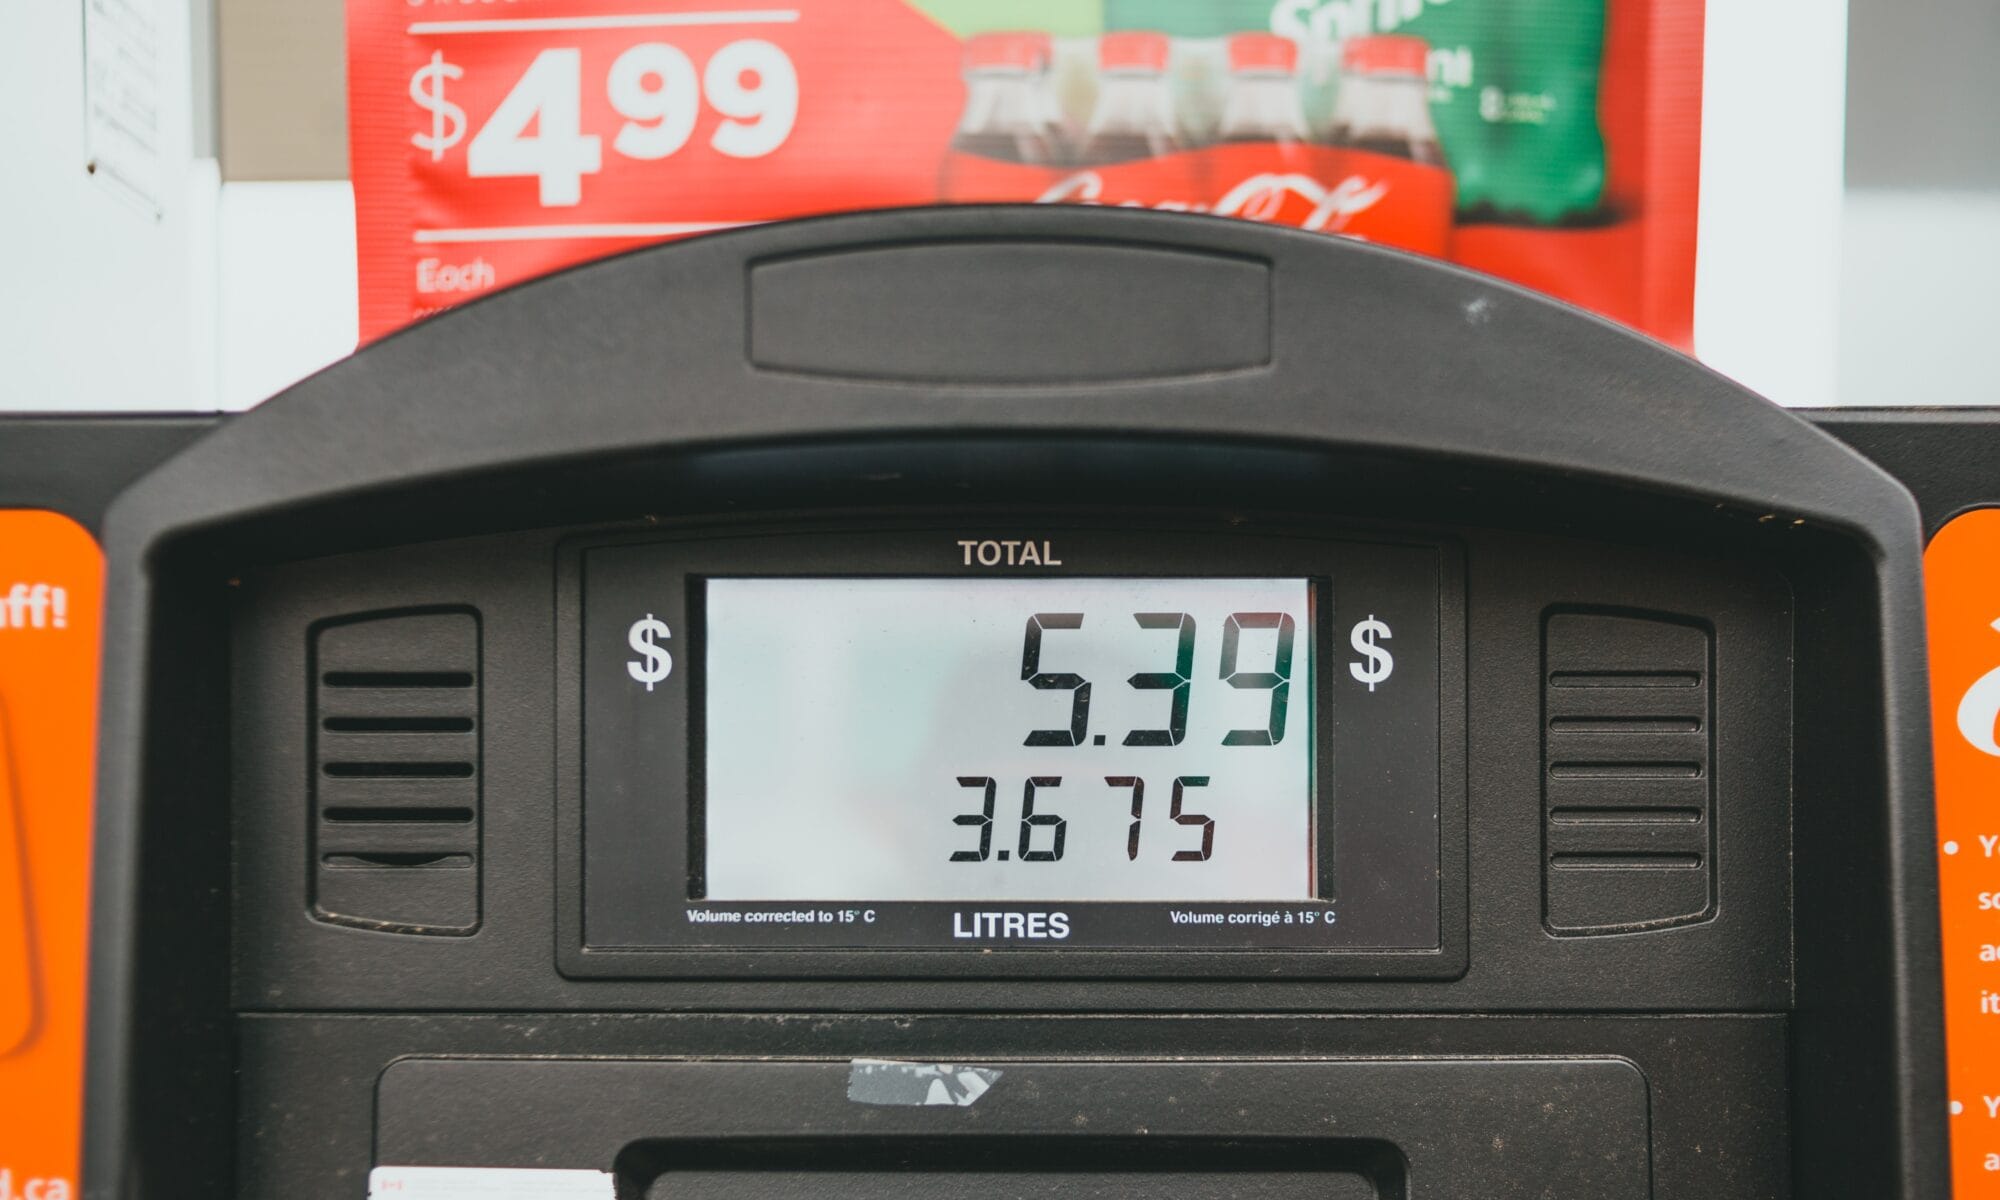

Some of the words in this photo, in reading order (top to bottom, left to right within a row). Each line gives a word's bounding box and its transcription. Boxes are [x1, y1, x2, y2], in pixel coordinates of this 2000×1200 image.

[416, 257, 496, 293] Each
[957, 540, 1063, 567] TOTAL
[626, 613, 673, 692] $
[1348, 614, 1395, 693] $
[1020, 612, 1296, 748] 5.39
[948, 775, 1216, 863] 3.675
[1978, 835, 2000, 858] Y
[686, 909, 742, 923] Volume
[743, 909, 815, 923] corrected
[818, 909, 834, 923] to
[837, 909, 861, 923] 15°
[863, 909, 876, 923] C
[953, 911, 1070, 939] LITRES
[1170, 910, 1225, 924] Volume
[1227, 910, 1281, 927] corrigé
[1283, 910, 1294, 924] à
[1297, 910, 1320, 924] 15°
[1324, 910, 1336, 924] C
[1979, 944, 2000, 962] a
